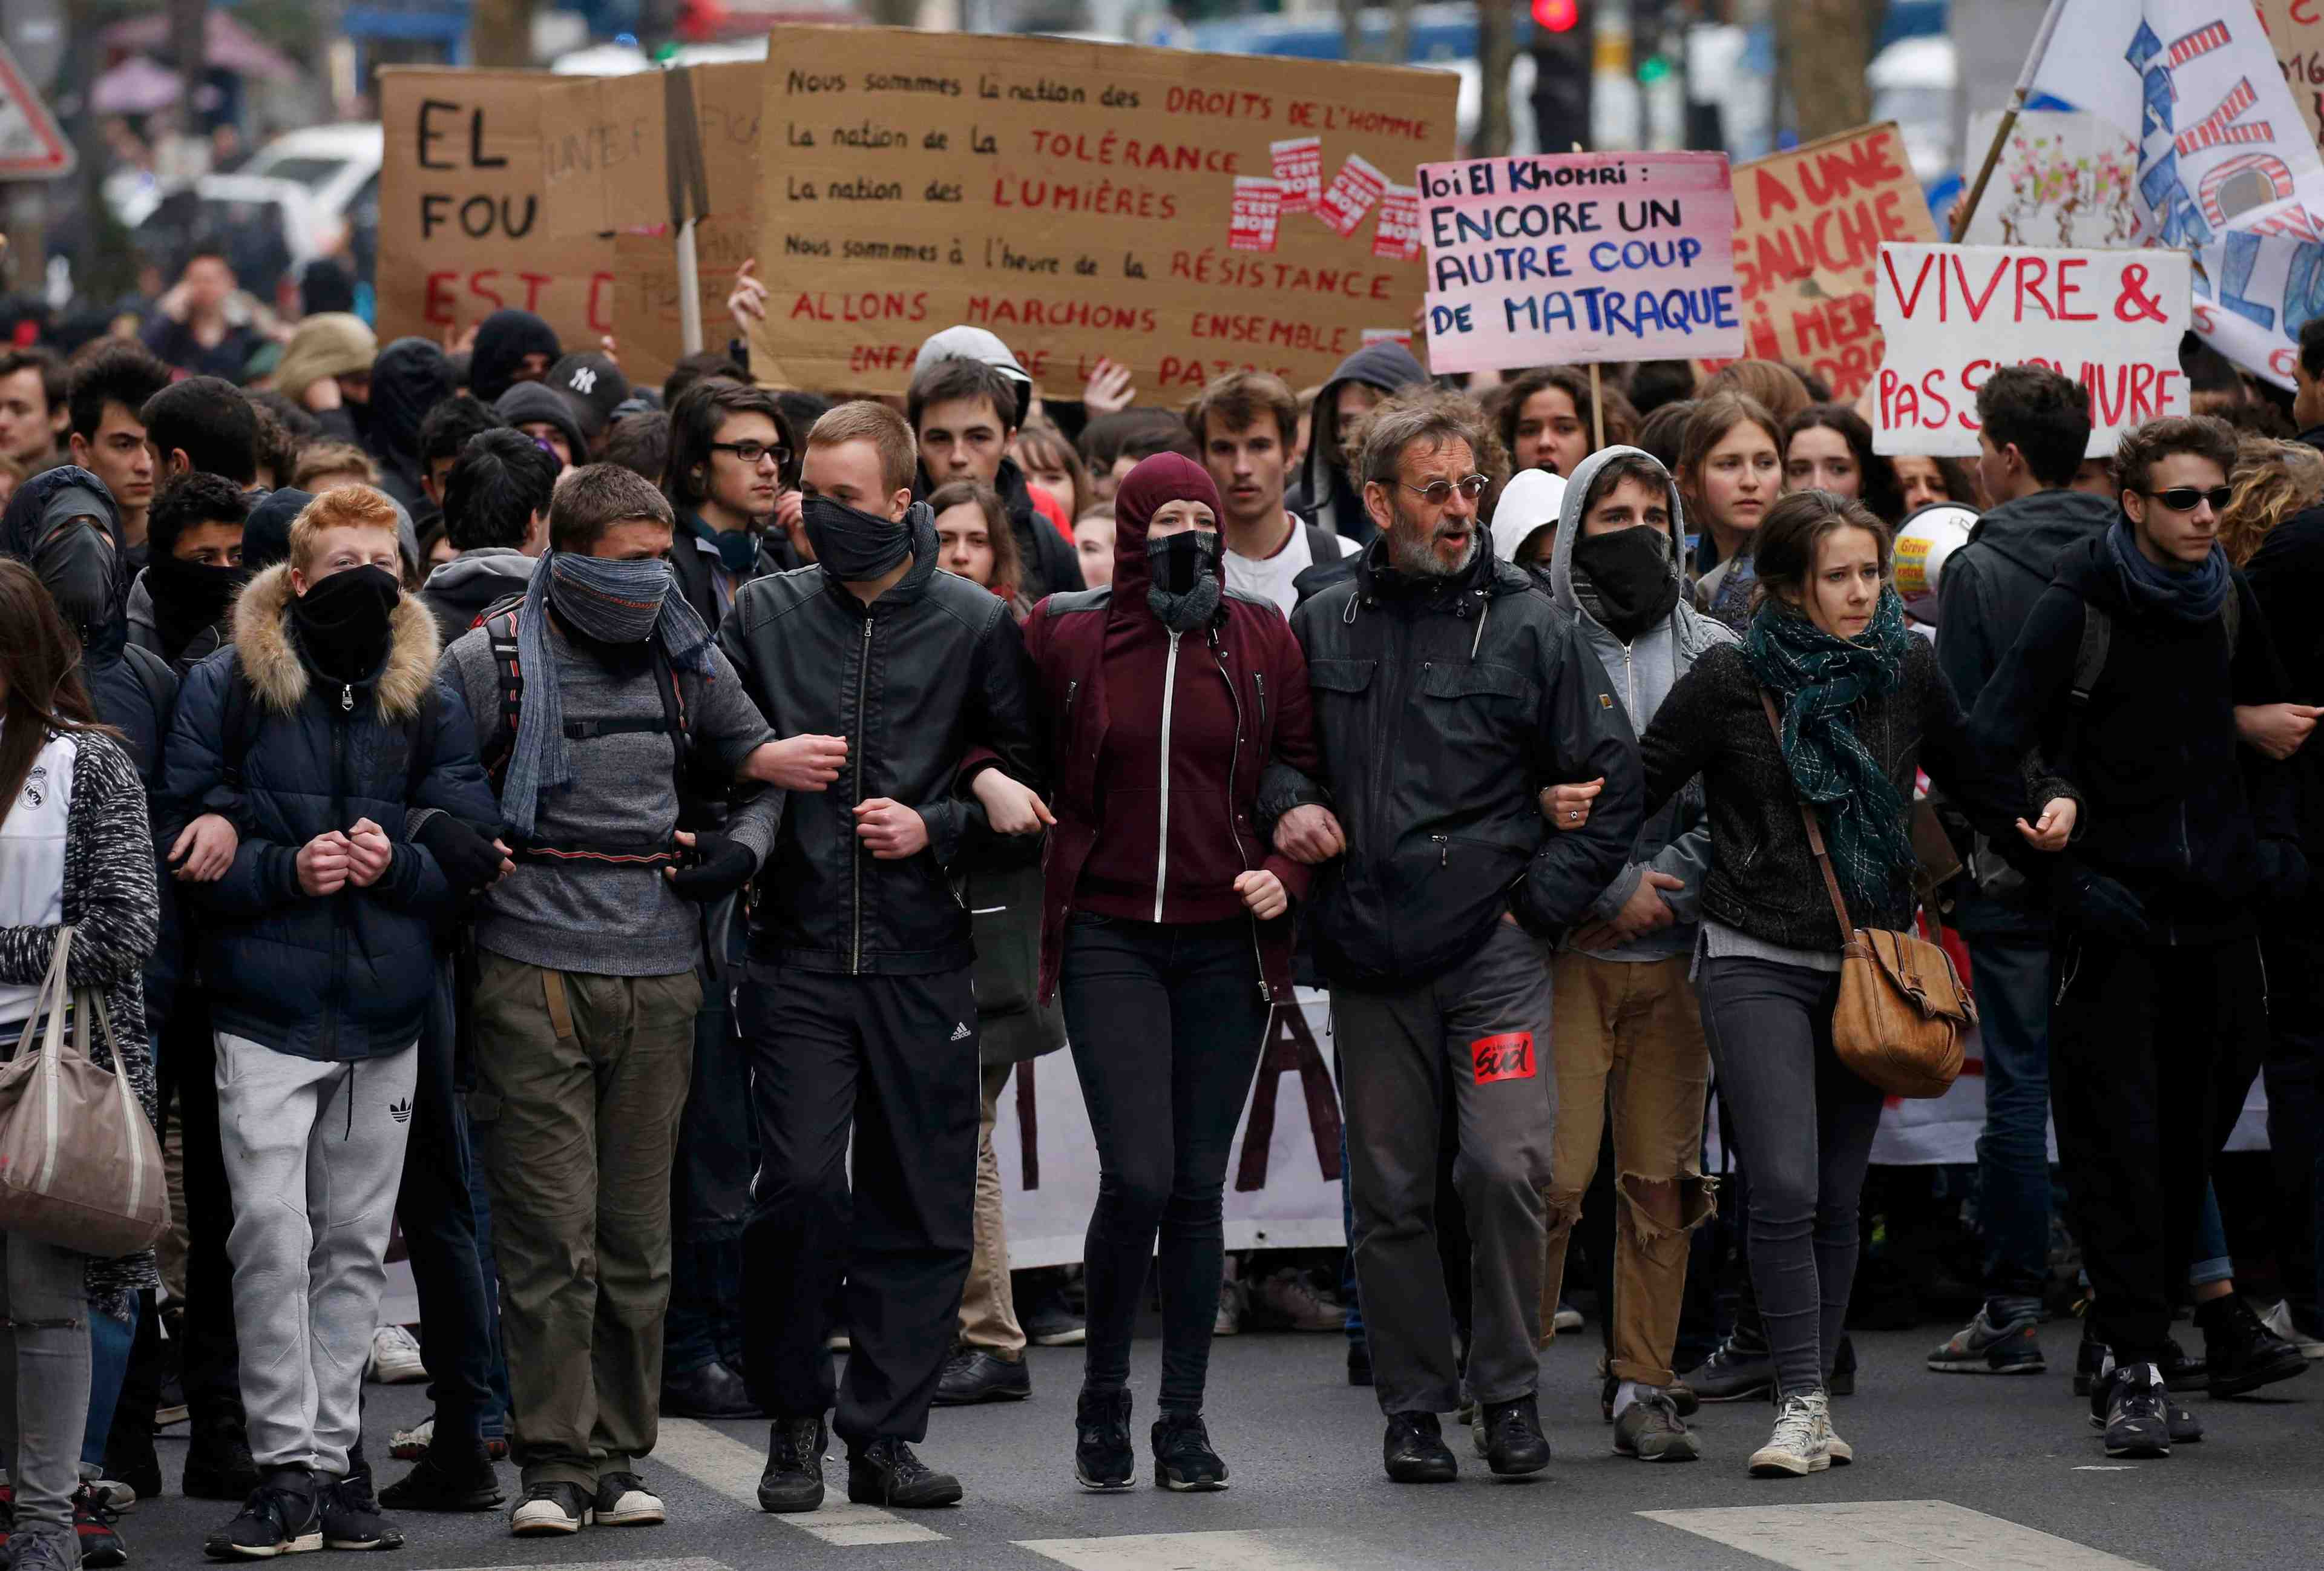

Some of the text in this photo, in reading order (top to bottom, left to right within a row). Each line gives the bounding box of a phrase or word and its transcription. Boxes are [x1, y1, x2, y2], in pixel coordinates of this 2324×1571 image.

[787, 70, 846, 96] Nous
[864, 71, 962, 96] sommes
[1008, 77, 1086, 103] nation
[1100, 84, 1140, 108] des
[1166, 85, 1272, 119] DROITS
[1288, 102, 1315, 128] DE
[1324, 105, 1433, 141] L'HOMME
[417, 99, 508, 170] EL
[832, 120, 907, 148] nation
[924, 127, 948, 151] de
[1031, 129, 1241, 175] TOLÉRANCE
[829, 177, 902, 201] nation
[925, 179, 963, 202] des
[1430, 199, 1681, 248] ENCORE UN
[786, 234, 832, 257] Nous
[843, 239, 937, 262] sommes
[1074, 254, 1098, 277] de
[1435, 237, 1702, 292] AUTRE COUP
[1430, 303, 1474, 335] DE
[1504, 285, 1739, 339] MATRAQUE
[1882, 250, 2168, 324] VIVRE &
[790, 291, 1350, 355] ALLONS MARCHONS ENSEMBLE
[1879, 368, 1952, 431] PAS
